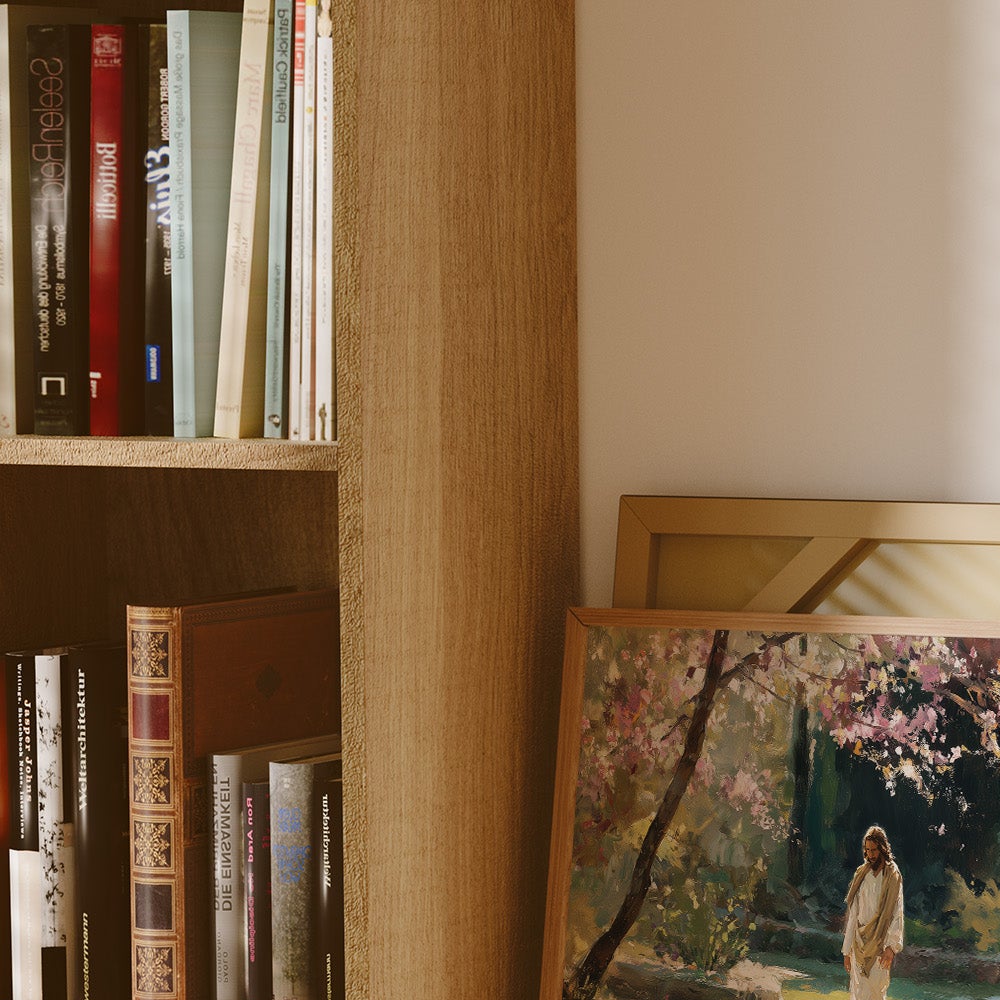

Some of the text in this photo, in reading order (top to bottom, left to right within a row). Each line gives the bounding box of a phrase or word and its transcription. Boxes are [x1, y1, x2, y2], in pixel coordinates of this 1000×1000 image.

[17, 664, 25, 705] Writings,
[17, 707, 25, 757] Sketchbook
[23, 700, 33, 802] Jasper Johns
[77, 669, 87, 811] Weltarchitektur
[18, 760, 26, 788] Notes,
